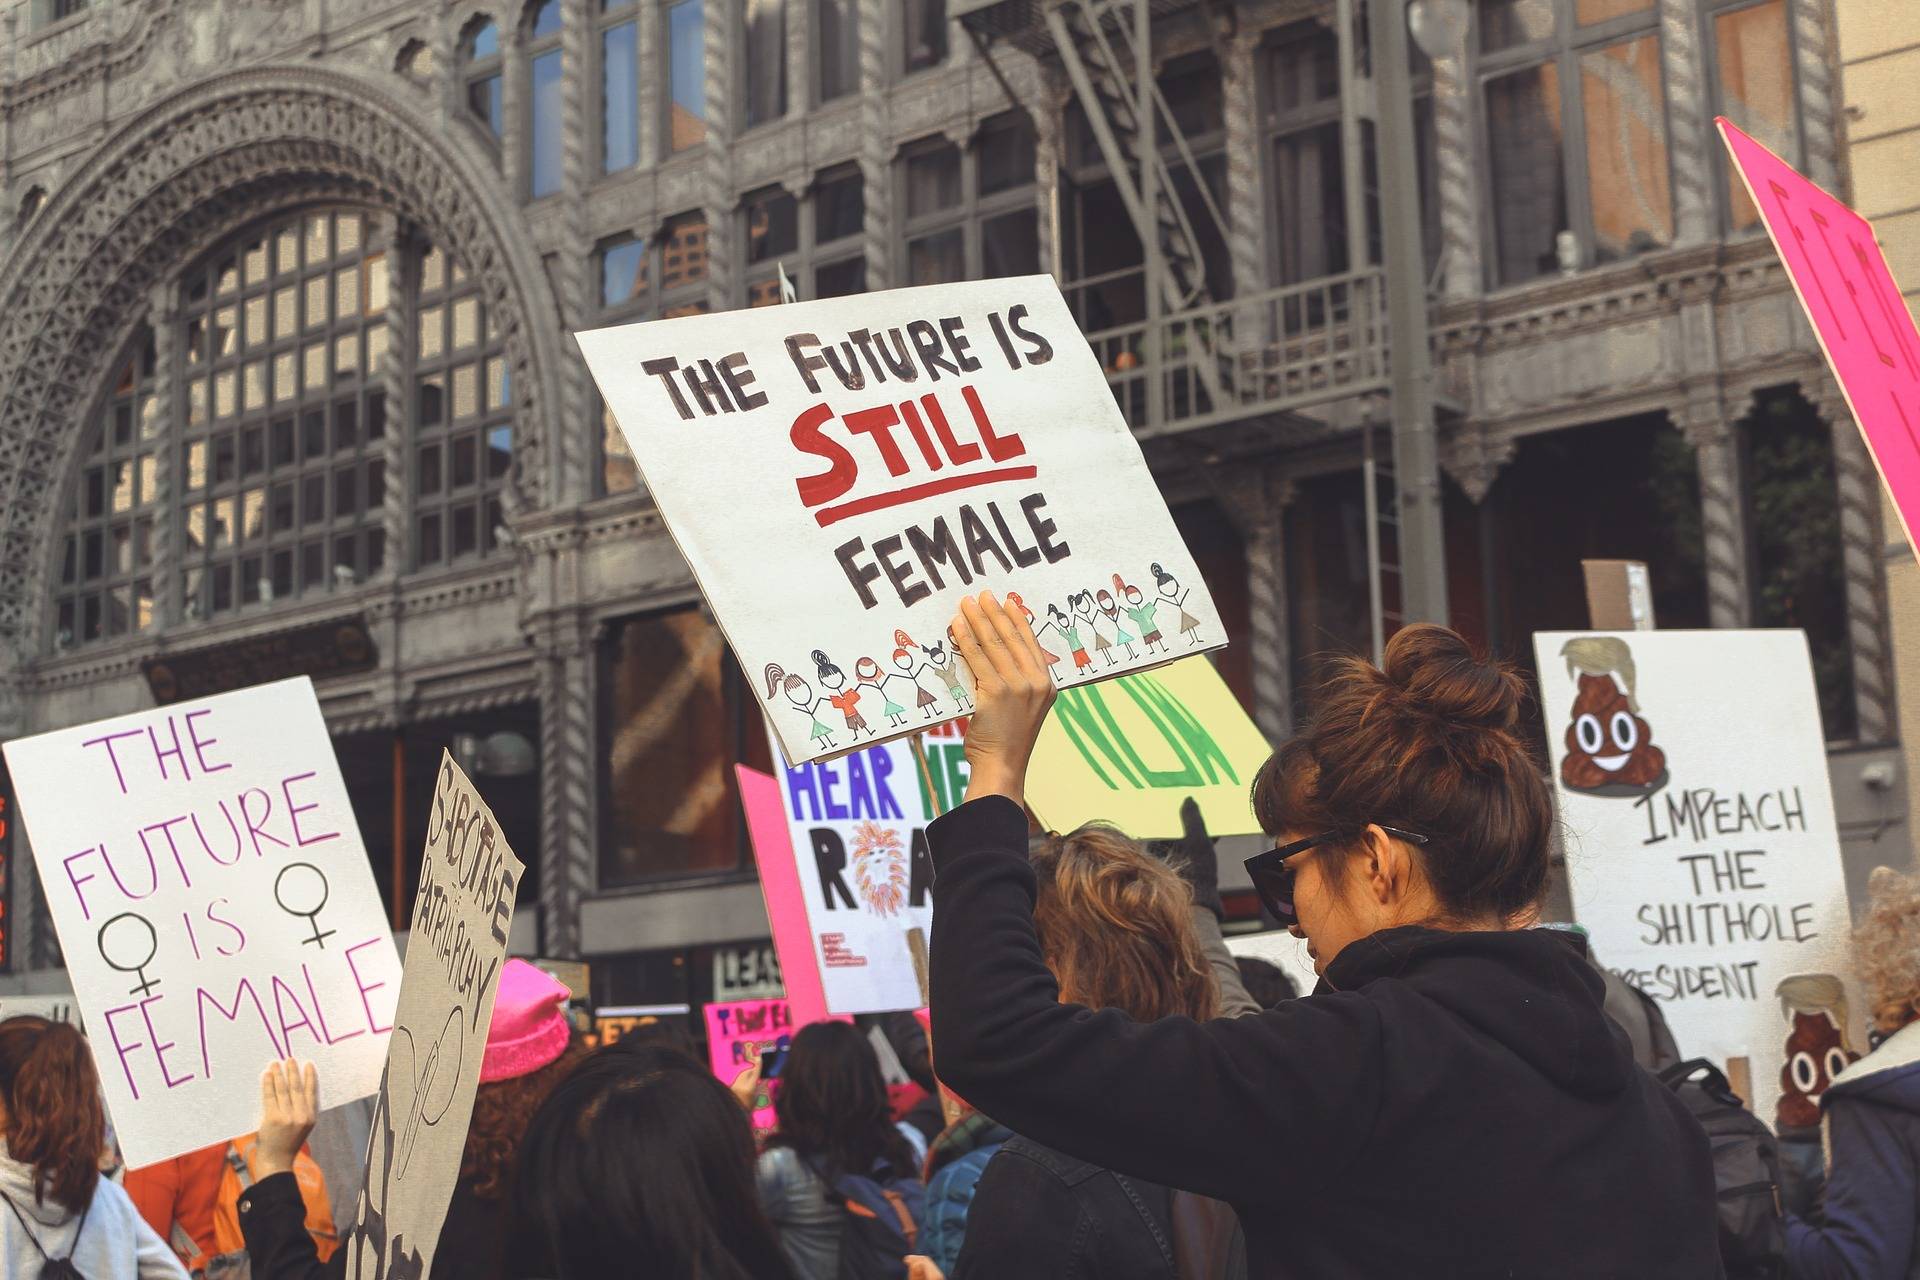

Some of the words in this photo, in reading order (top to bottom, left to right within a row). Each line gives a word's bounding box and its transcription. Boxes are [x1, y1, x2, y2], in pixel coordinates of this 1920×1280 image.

[641, 352, 768, 420] THE
[784, 315, 983, 394] FUTURE
[988, 304, 1054, 371] IS
[789, 385, 1026, 508] STILL
[834, 492, 1071, 610] FEMALE
[82, 709, 232, 793] THE
[782, 745, 904, 821] HEAR
[63, 771, 341, 920] FUTURE
[429, 759, 515, 948] SABOTAGE
[1633, 787, 1807, 845] IMPEACH
[1678, 850, 1766, 896] THE
[183, 897, 246, 960] IS
[417, 853, 498, 1034] PATRIARCHY
[1636, 903, 1819, 948] SHITHOLE
[105, 936, 394, 1100] FEMALE
